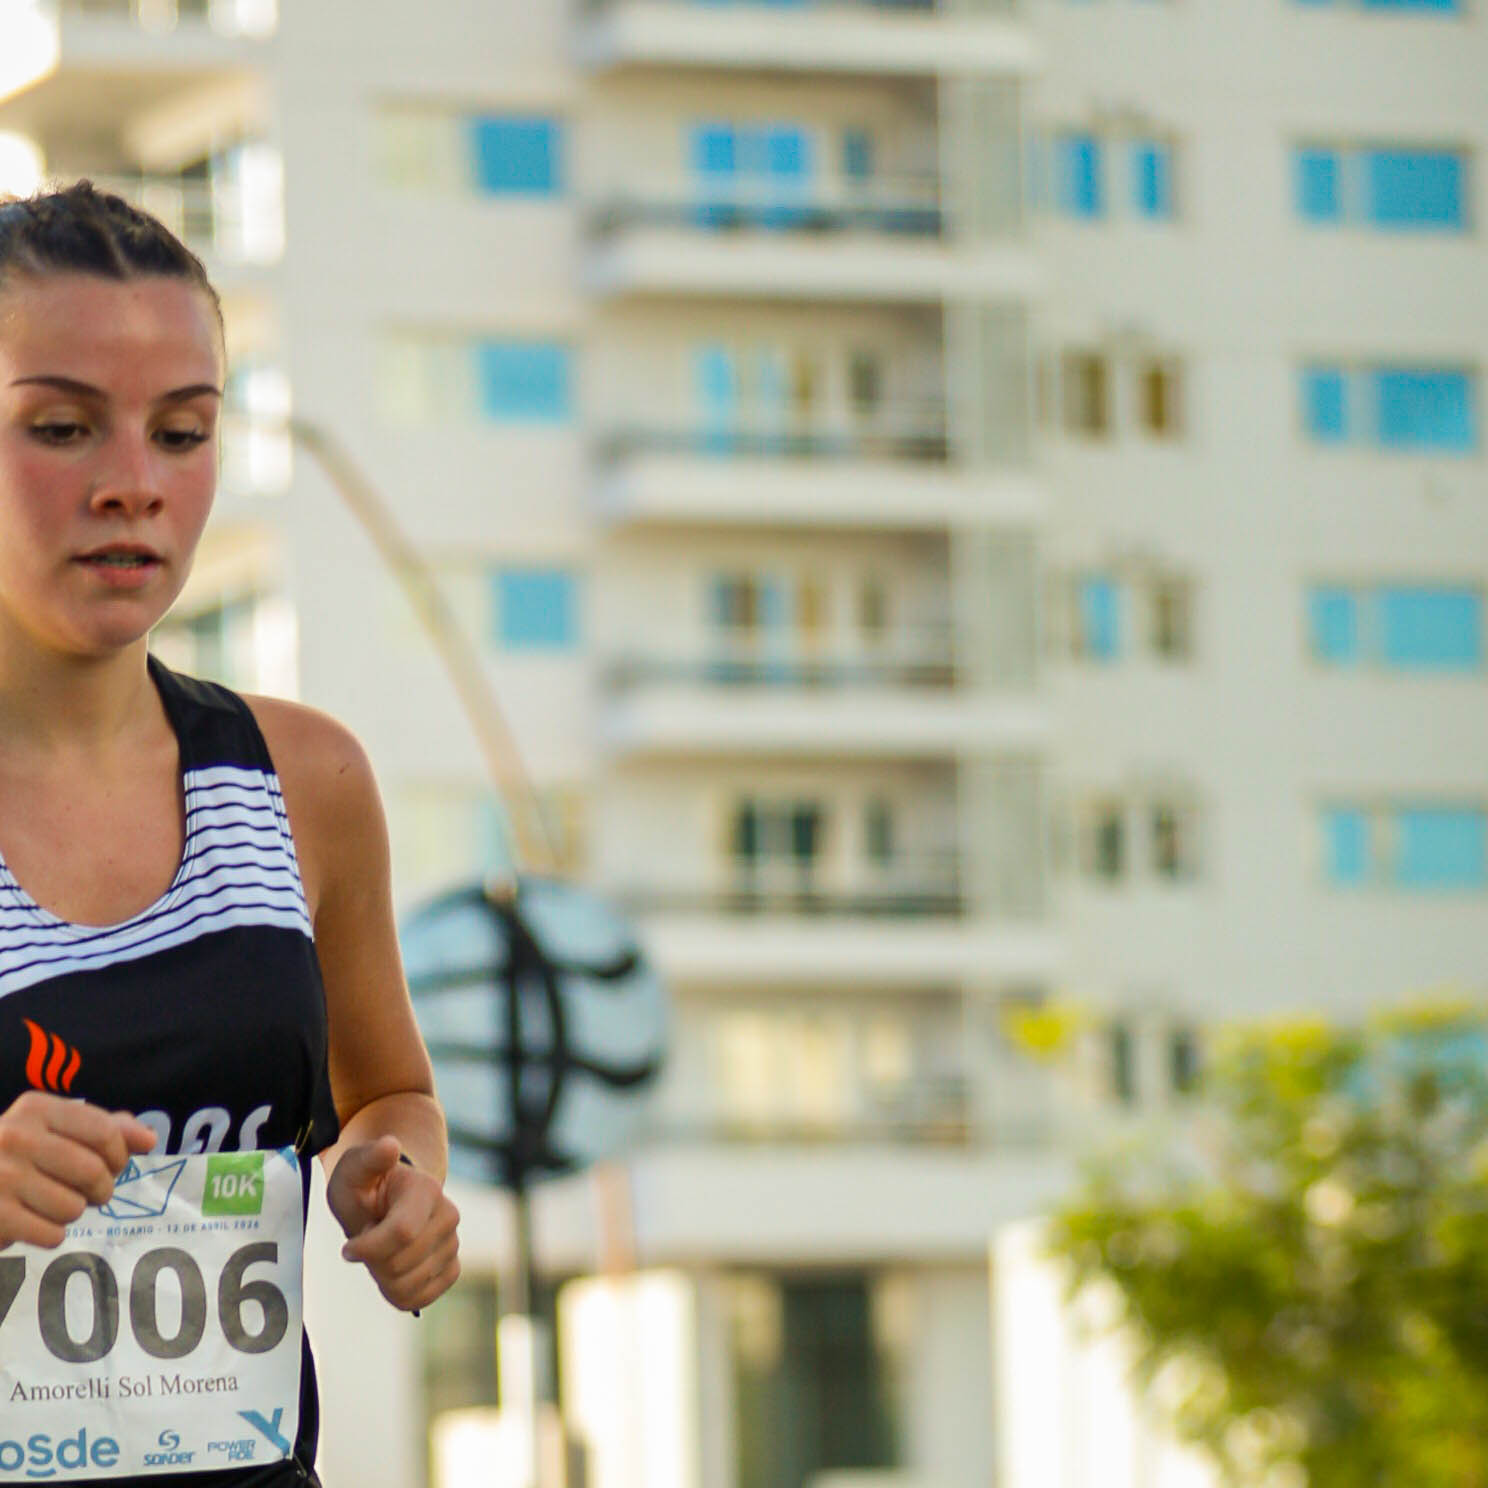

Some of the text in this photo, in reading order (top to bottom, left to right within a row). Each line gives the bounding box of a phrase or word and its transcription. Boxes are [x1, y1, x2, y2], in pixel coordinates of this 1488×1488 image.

[212, 1174, 258, 1199] 10K
[106, 1225, 153, 1237] ROSARIO
[183, 1223, 196, 1233] DE
[201, 1221, 229, 1232] ABRIL
[10, 1373, 239, 1402] Amorelli Sol Morena
